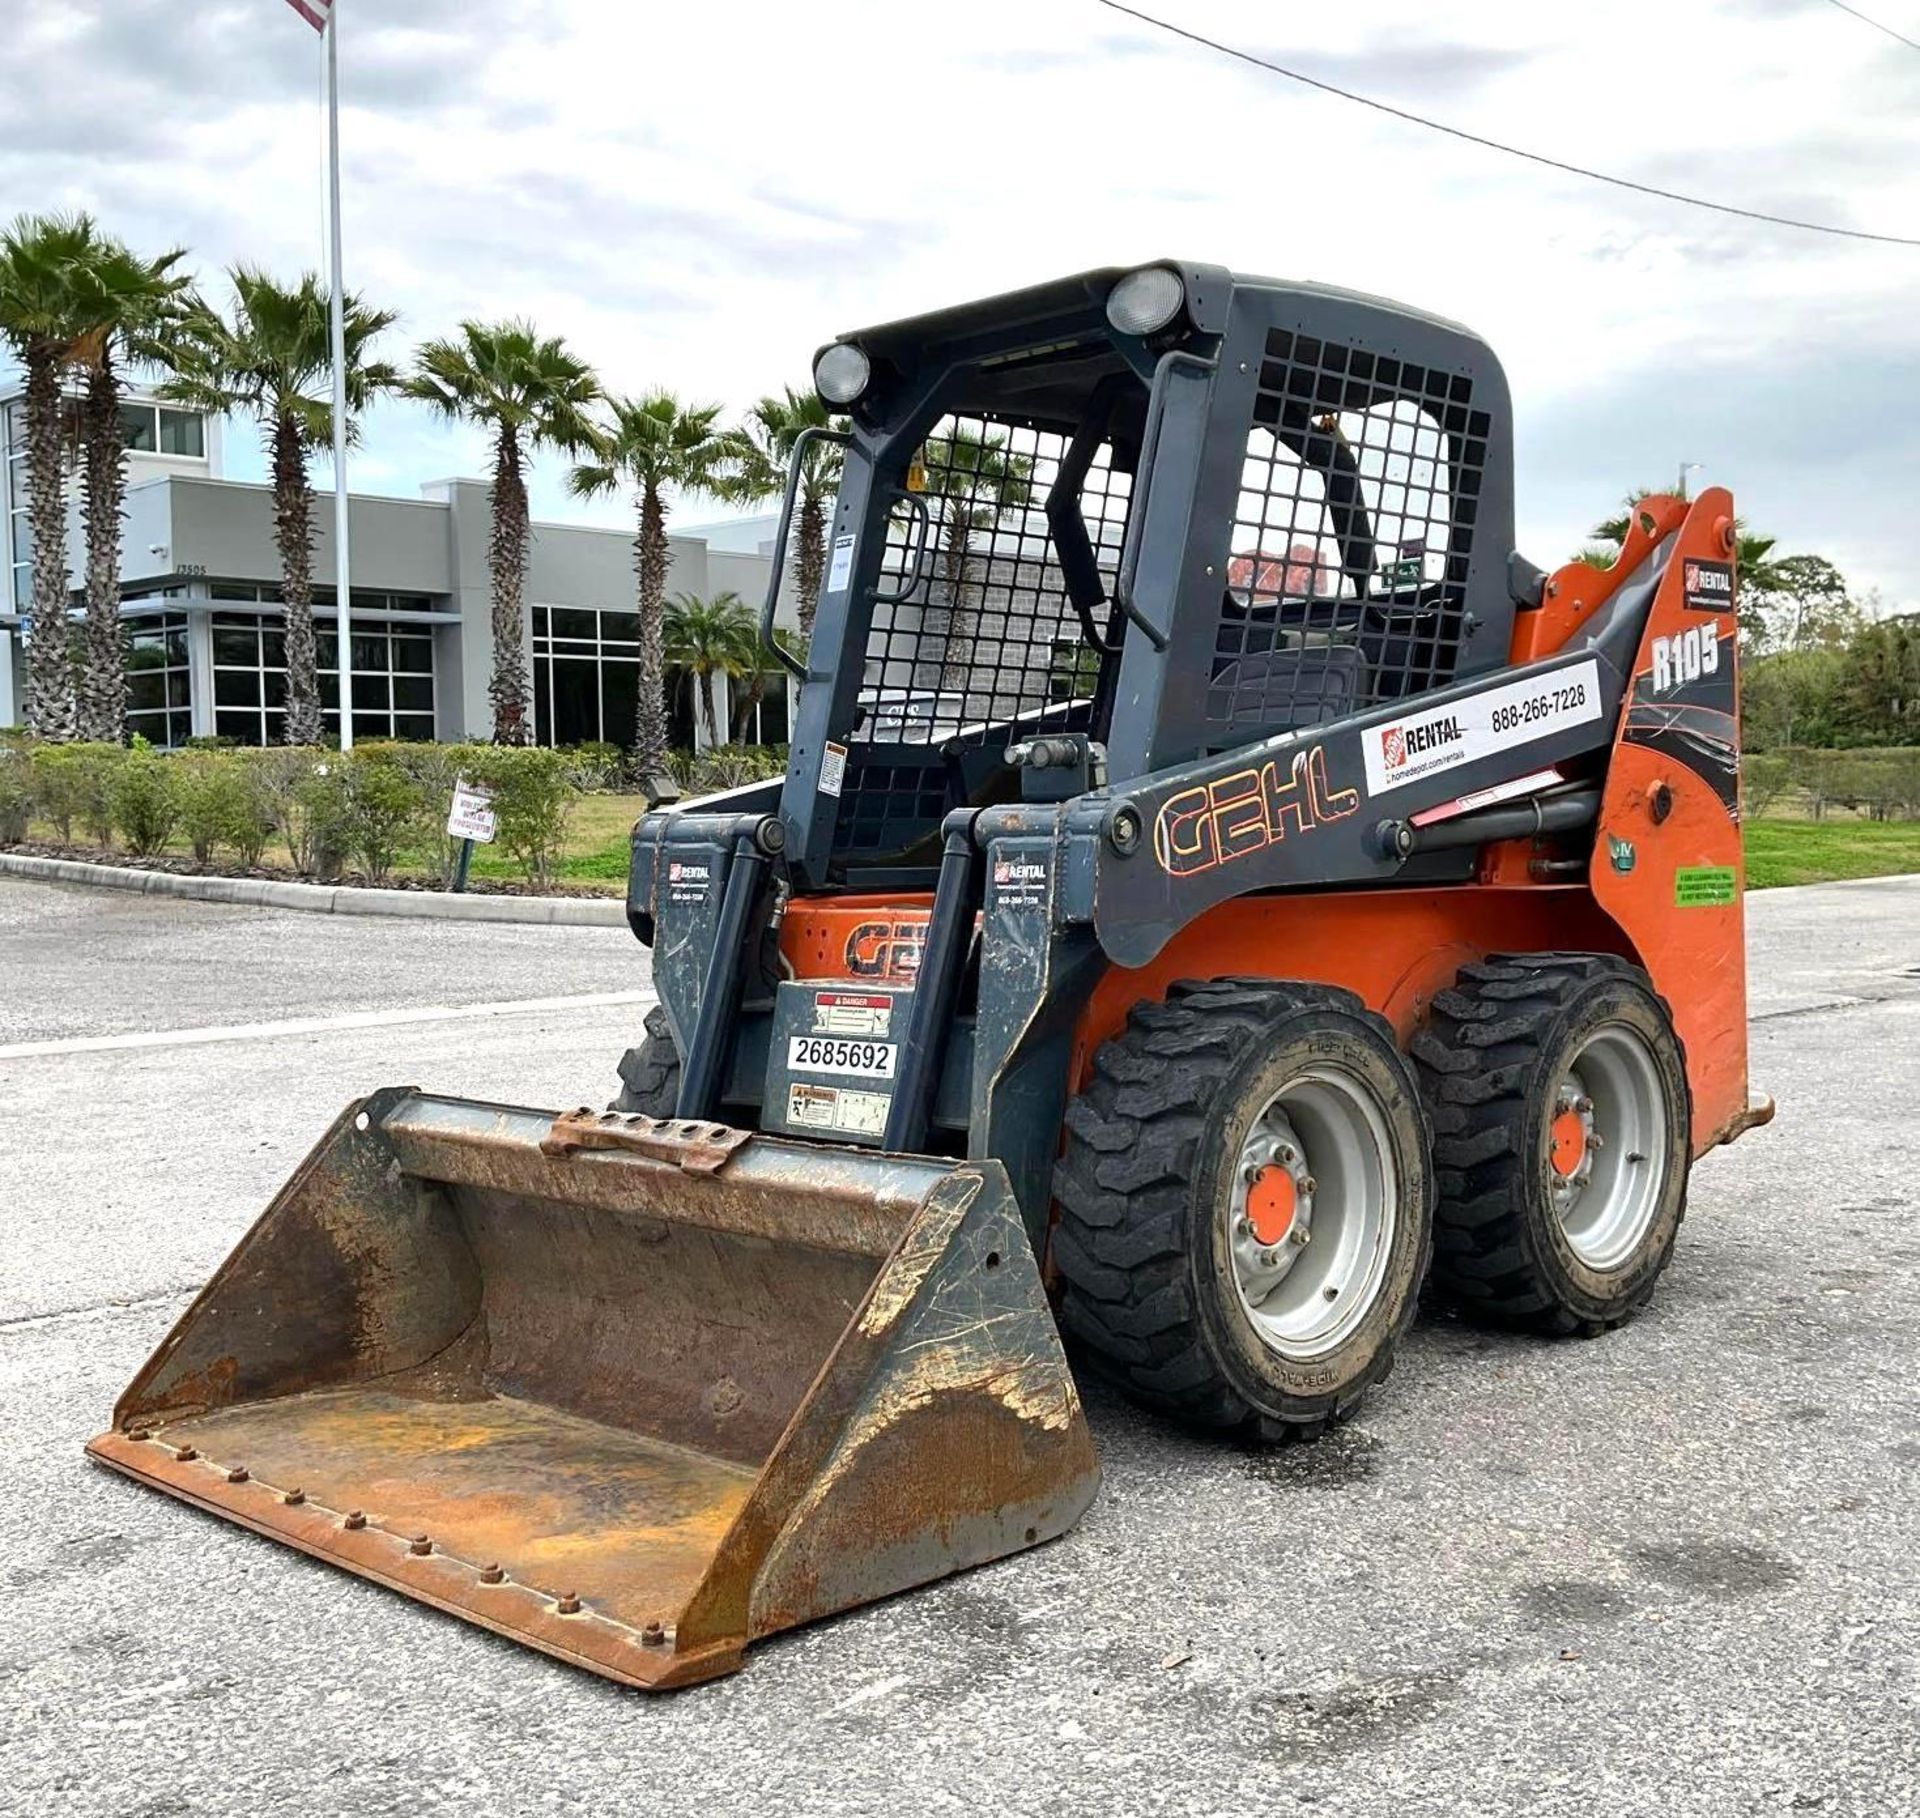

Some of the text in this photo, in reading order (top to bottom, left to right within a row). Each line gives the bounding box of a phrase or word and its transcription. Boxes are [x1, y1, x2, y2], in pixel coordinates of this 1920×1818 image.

[1699, 570, 1732, 592] RENTAL
[1652, 621, 1719, 694] R105
[1492, 684, 1586, 733] 888-266-7228
[1405, 716, 1463, 755] RENTAL
[1391, 750, 1465, 782] homedepot.com/rentals
[1154, 745, 1360, 877] GEHL
[1009, 864, 1046, 879] RENTAL
[842, 996, 868, 1006] DANGER
[795, 1039, 889, 1070] 2685692
